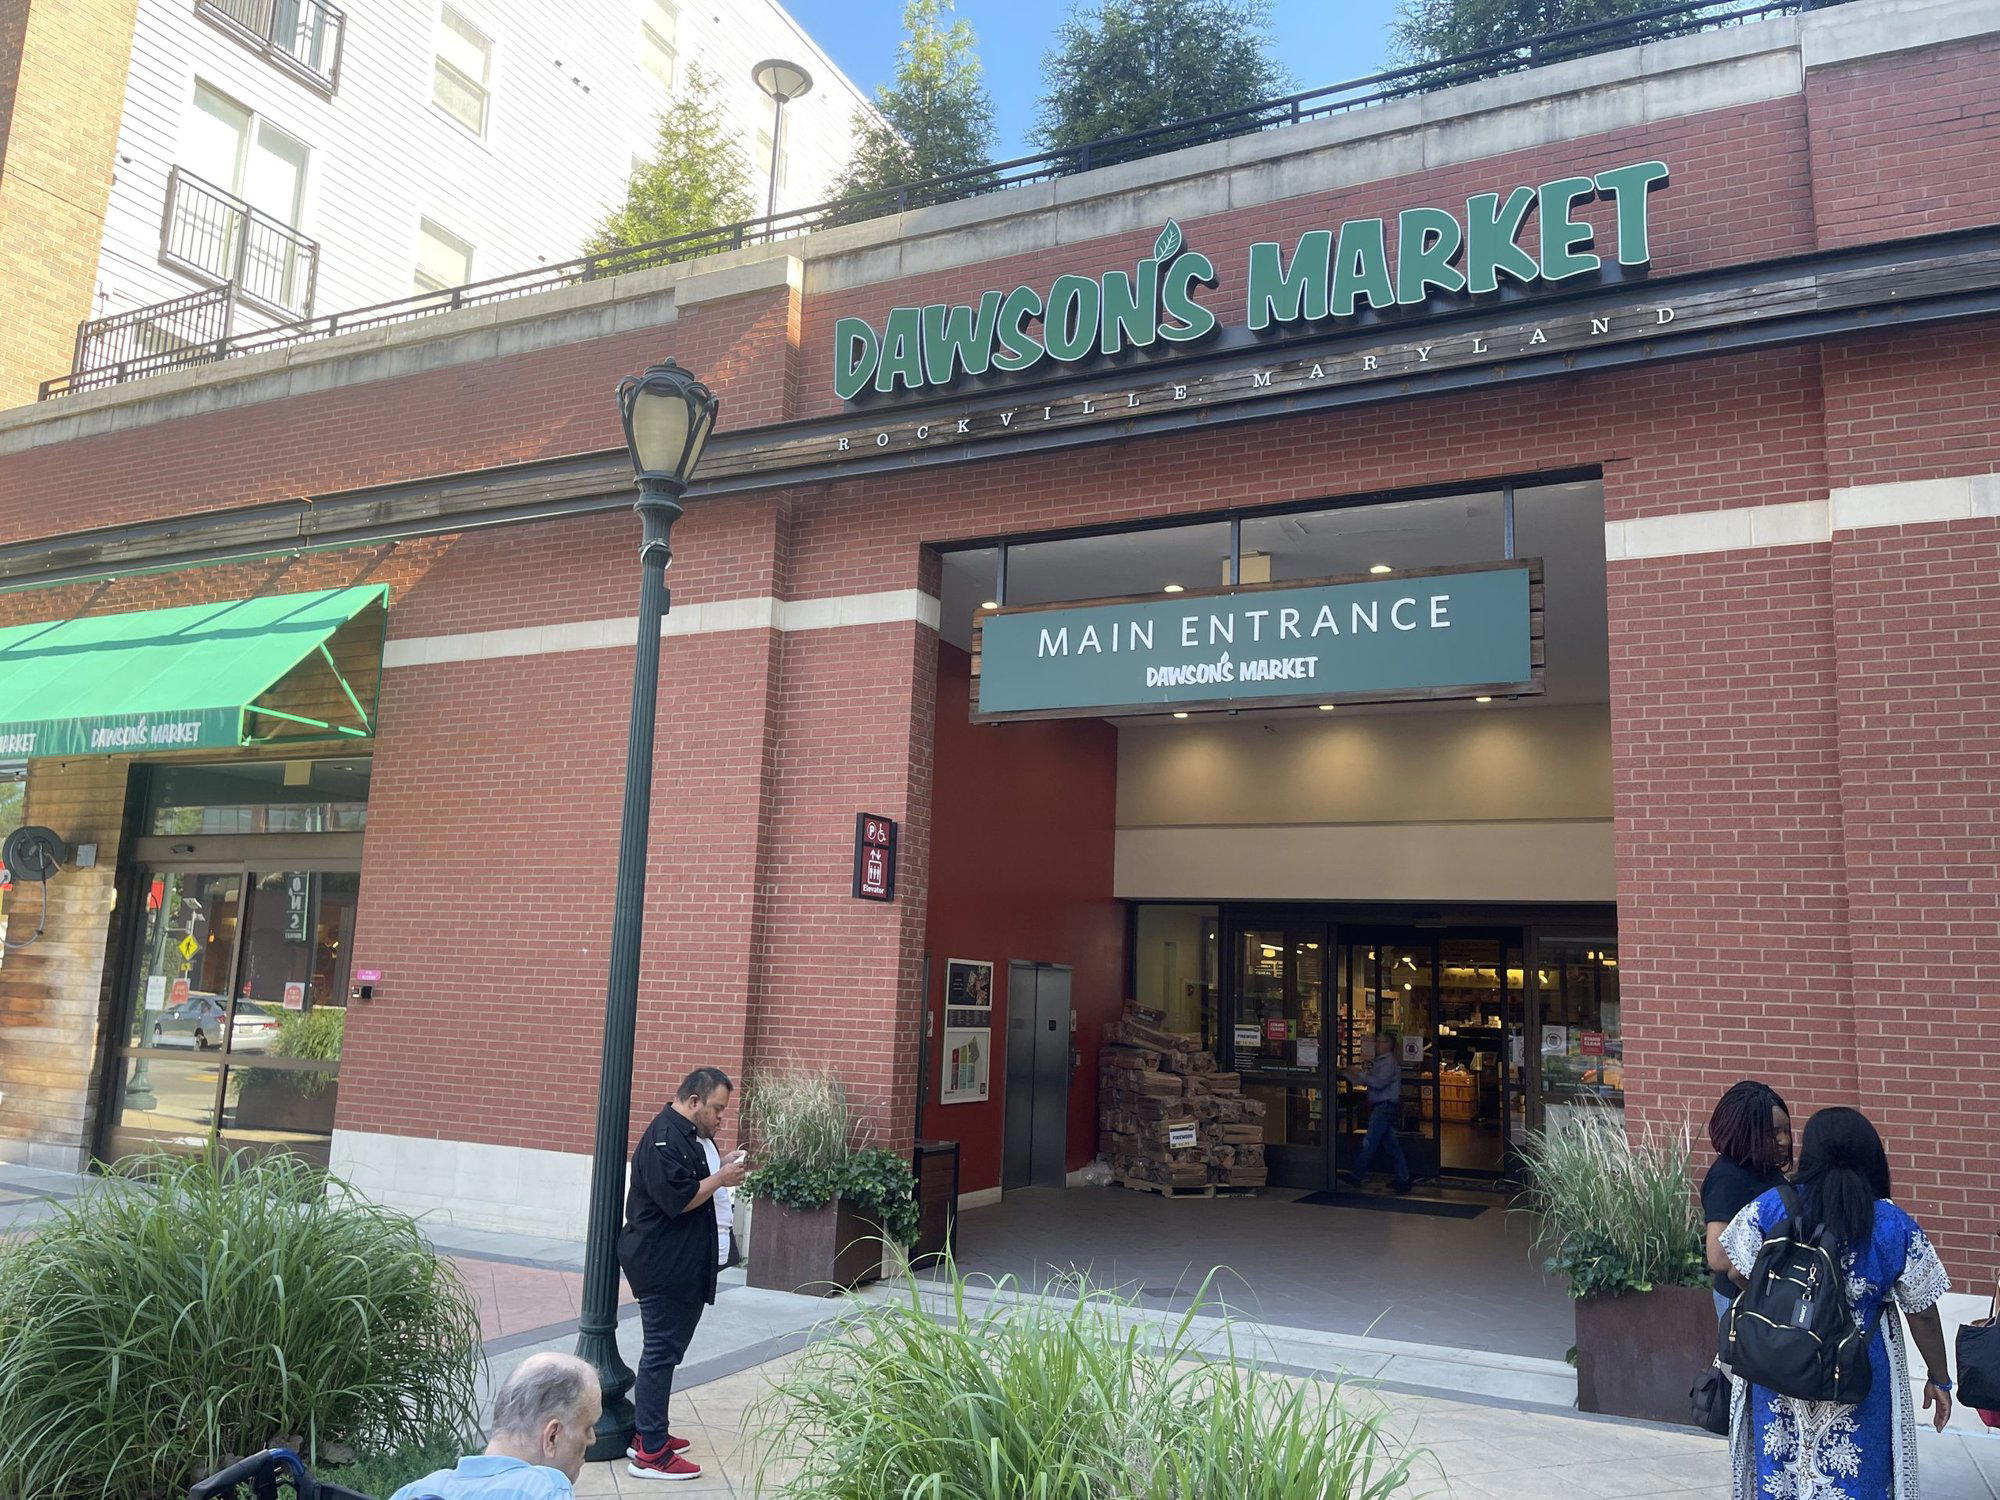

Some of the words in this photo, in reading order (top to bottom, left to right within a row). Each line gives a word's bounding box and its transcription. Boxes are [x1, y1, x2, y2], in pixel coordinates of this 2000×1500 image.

[835, 217, 1215, 399] DAWSON'S
[1248, 161, 1669, 330] MARKET
[838, 385, 1187, 451] ROCKVILLE
[1253, 308, 1675, 388] MARYLAND
[1038, 620, 1154, 657] MAIN
[1181, 595, 1451, 646] ENTRANCE
[1146, 651, 1234, 687] DAWSON'S
[1240, 656, 1318, 681] MARKET
[150, 722, 201, 744] MARKET
[862, 883, 885, 894] Elevator
